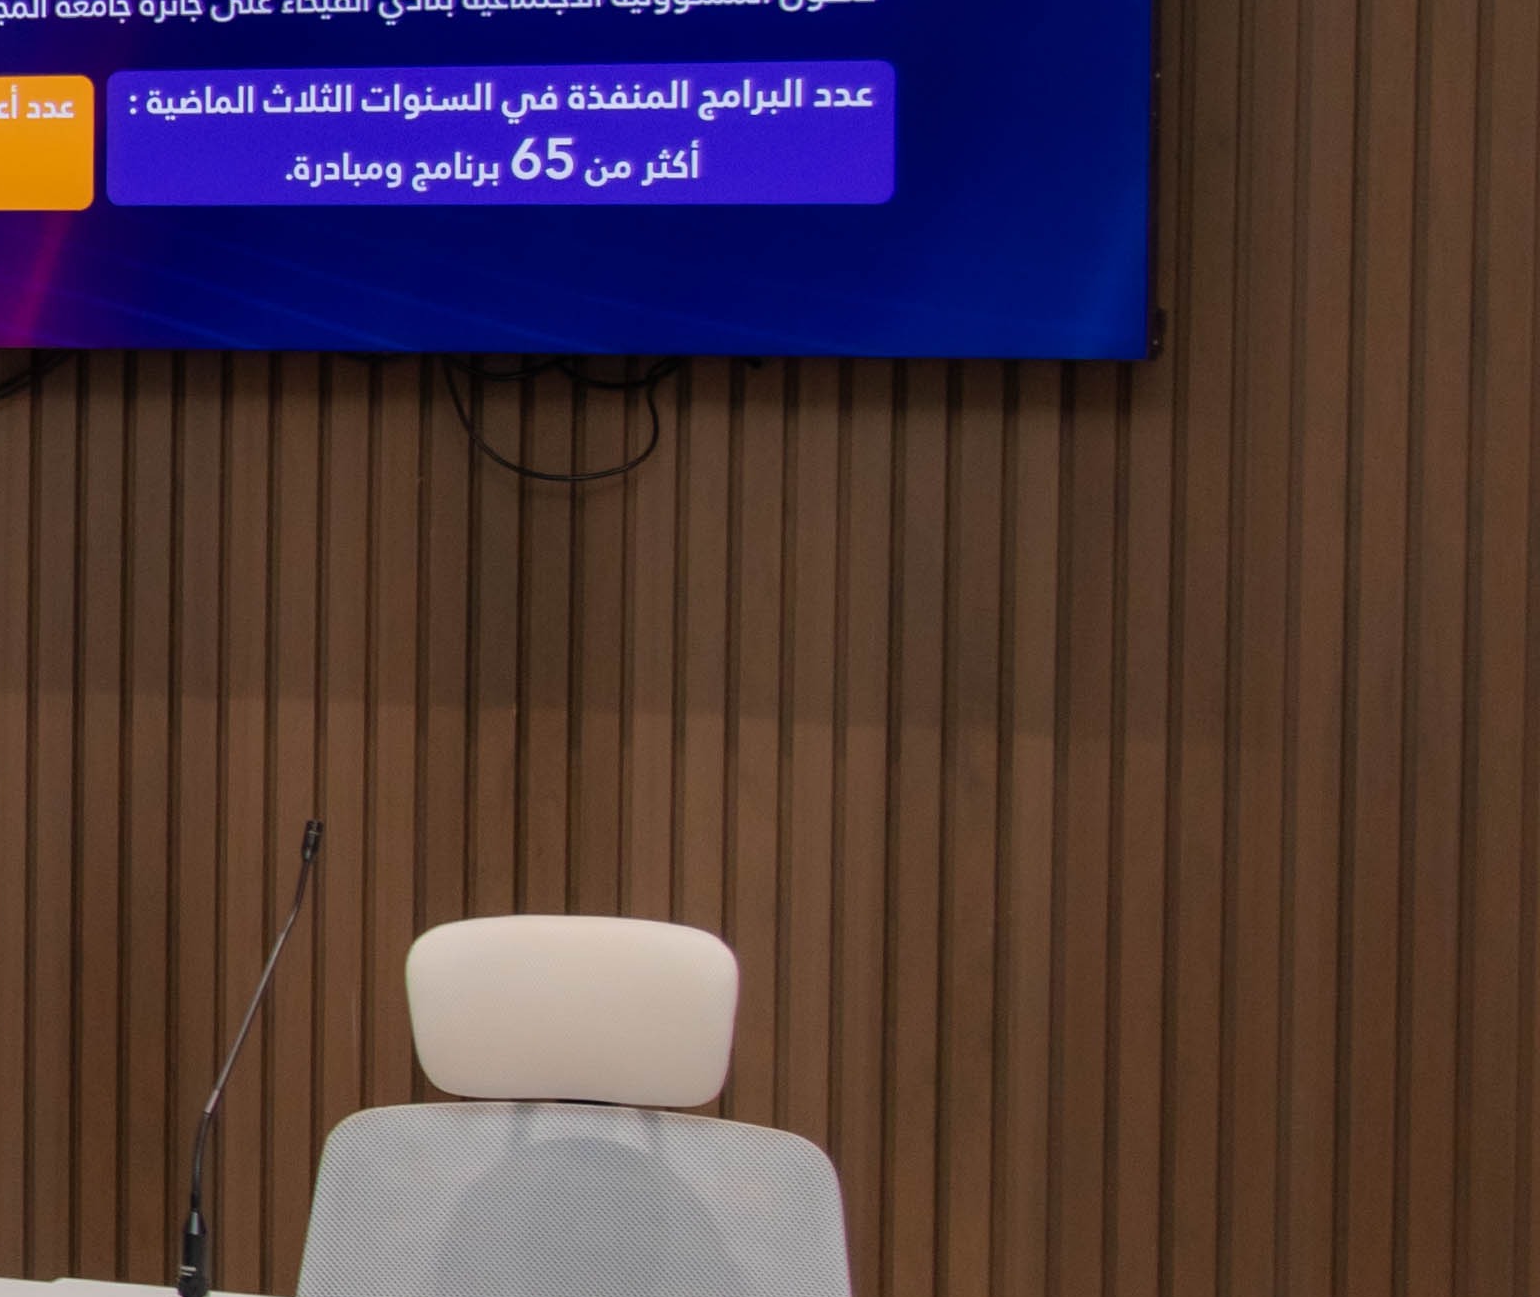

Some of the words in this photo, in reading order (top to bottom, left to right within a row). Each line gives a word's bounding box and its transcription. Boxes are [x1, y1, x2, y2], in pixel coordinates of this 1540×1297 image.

[25, 99, 76, 120] عدد
[145, 85, 254, 121] الماضية
[262, 83, 353, 114] الثلاث
[360, 81, 492, 120] السنوات
[500, 84, 559, 125] في
[567, 79, 689, 110] المنفذة
[697, 77, 803, 122] البرامج
[813, 87, 874, 108] عدد
[285, 151, 403, 189] ومبادرة.
[411, 150, 500, 193] برنامج
[510, 136, 575, 181] 65
[584, 157, 632, 188] من
[640, 139, 700, 187] أكثر
